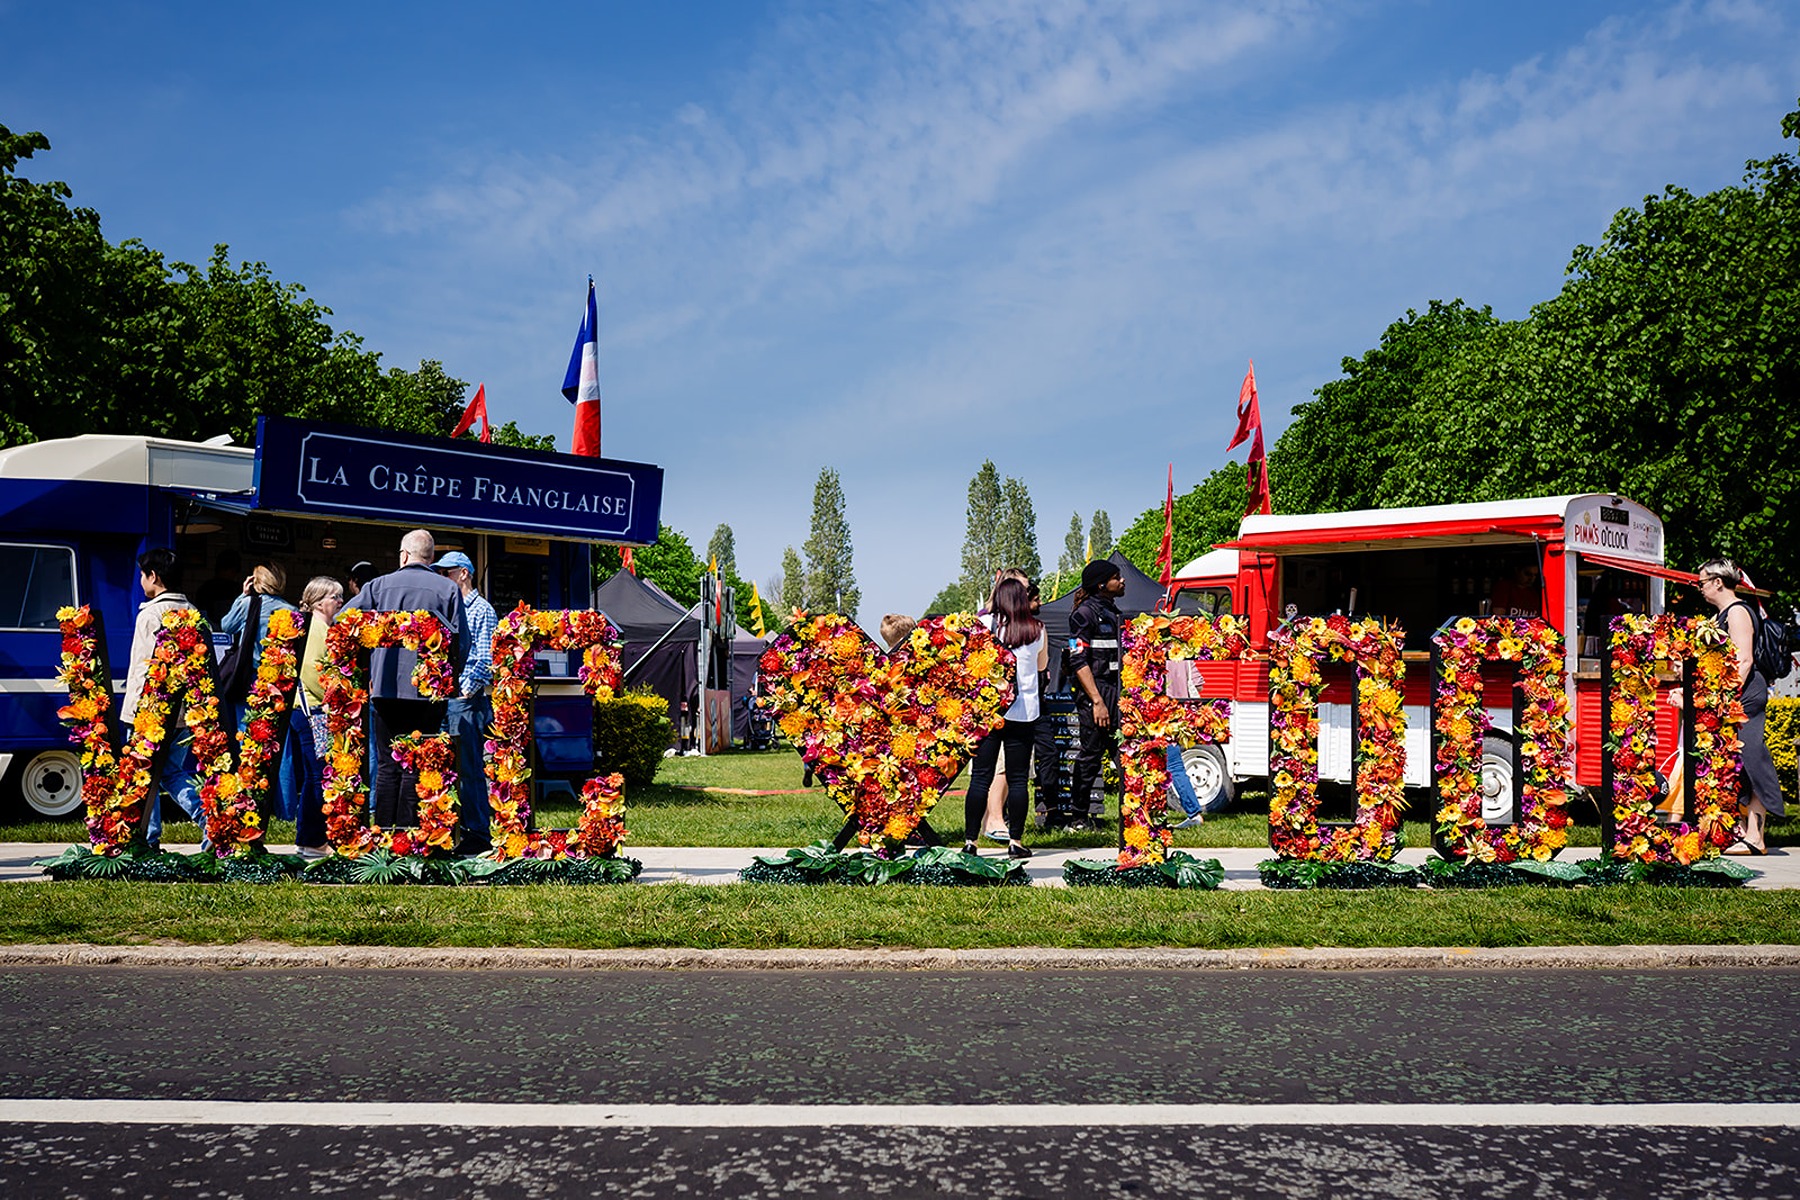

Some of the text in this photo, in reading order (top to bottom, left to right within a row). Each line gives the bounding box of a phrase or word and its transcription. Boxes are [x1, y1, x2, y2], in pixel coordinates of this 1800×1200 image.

[307, 456, 627, 517] LA CRÊPE FRANGLAISE
[1574, 523, 1629, 550] PIMM'S O'CLOCK
[55, 600, 1744, 868] WGC FOOD
